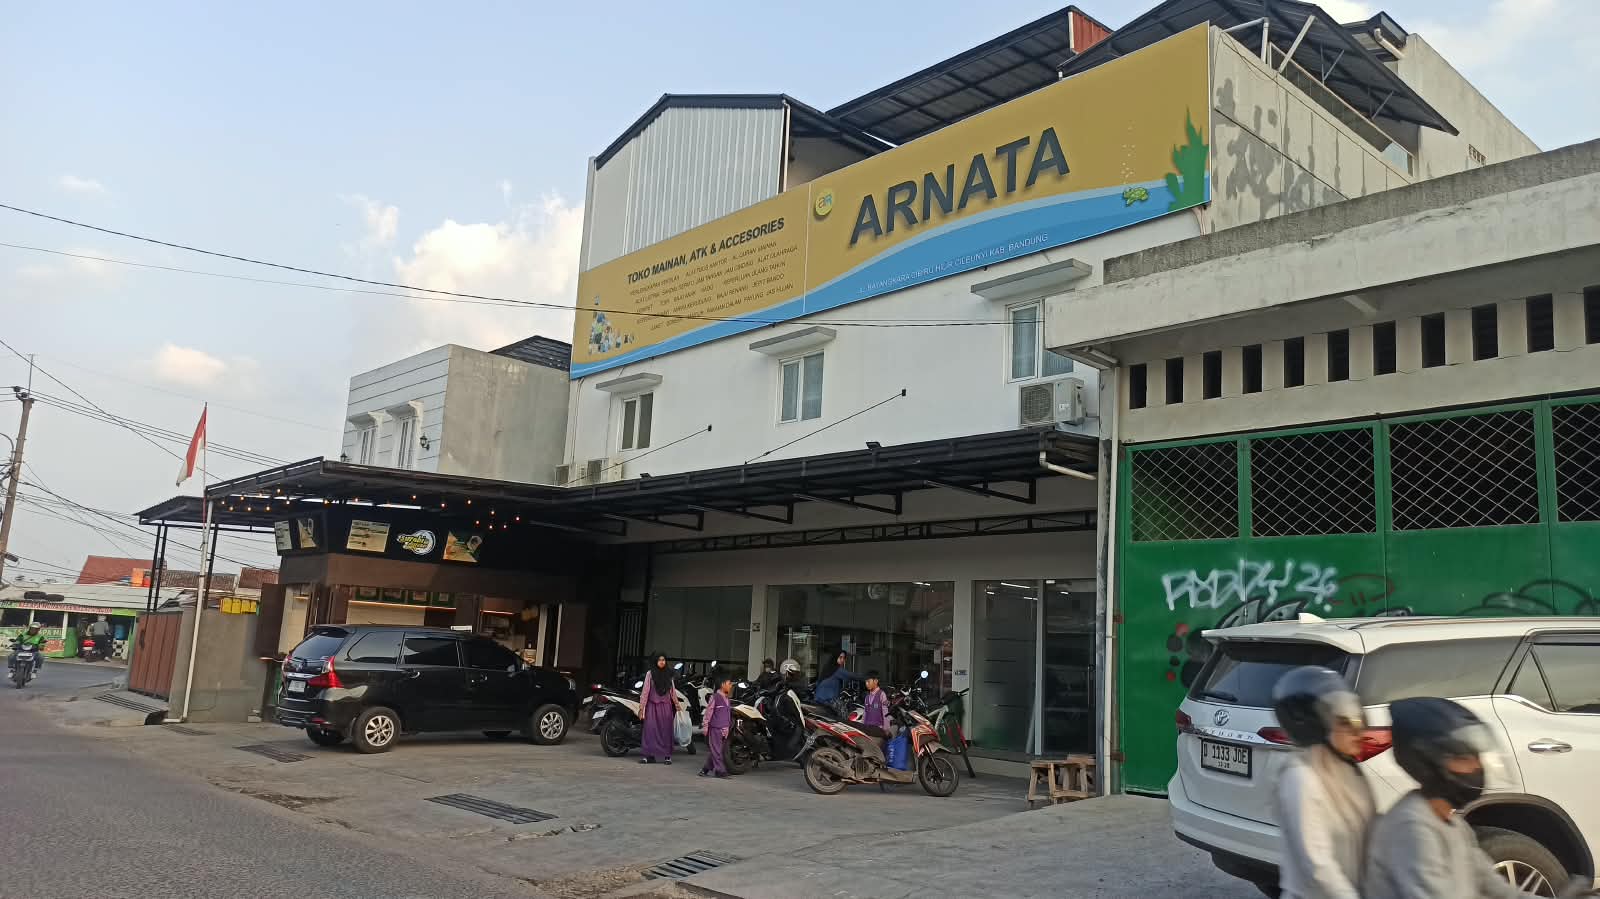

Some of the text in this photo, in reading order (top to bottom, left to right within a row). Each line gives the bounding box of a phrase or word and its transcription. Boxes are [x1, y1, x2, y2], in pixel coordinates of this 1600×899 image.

[850, 127, 1069, 245] ARNATA
[628, 217, 784, 285] TOKO MAINAN, ATK & ACCESORIES
[1008, 232, 1047, 251] BANDUNG
[1203, 743, 1248, 764] D 1133 JOE
